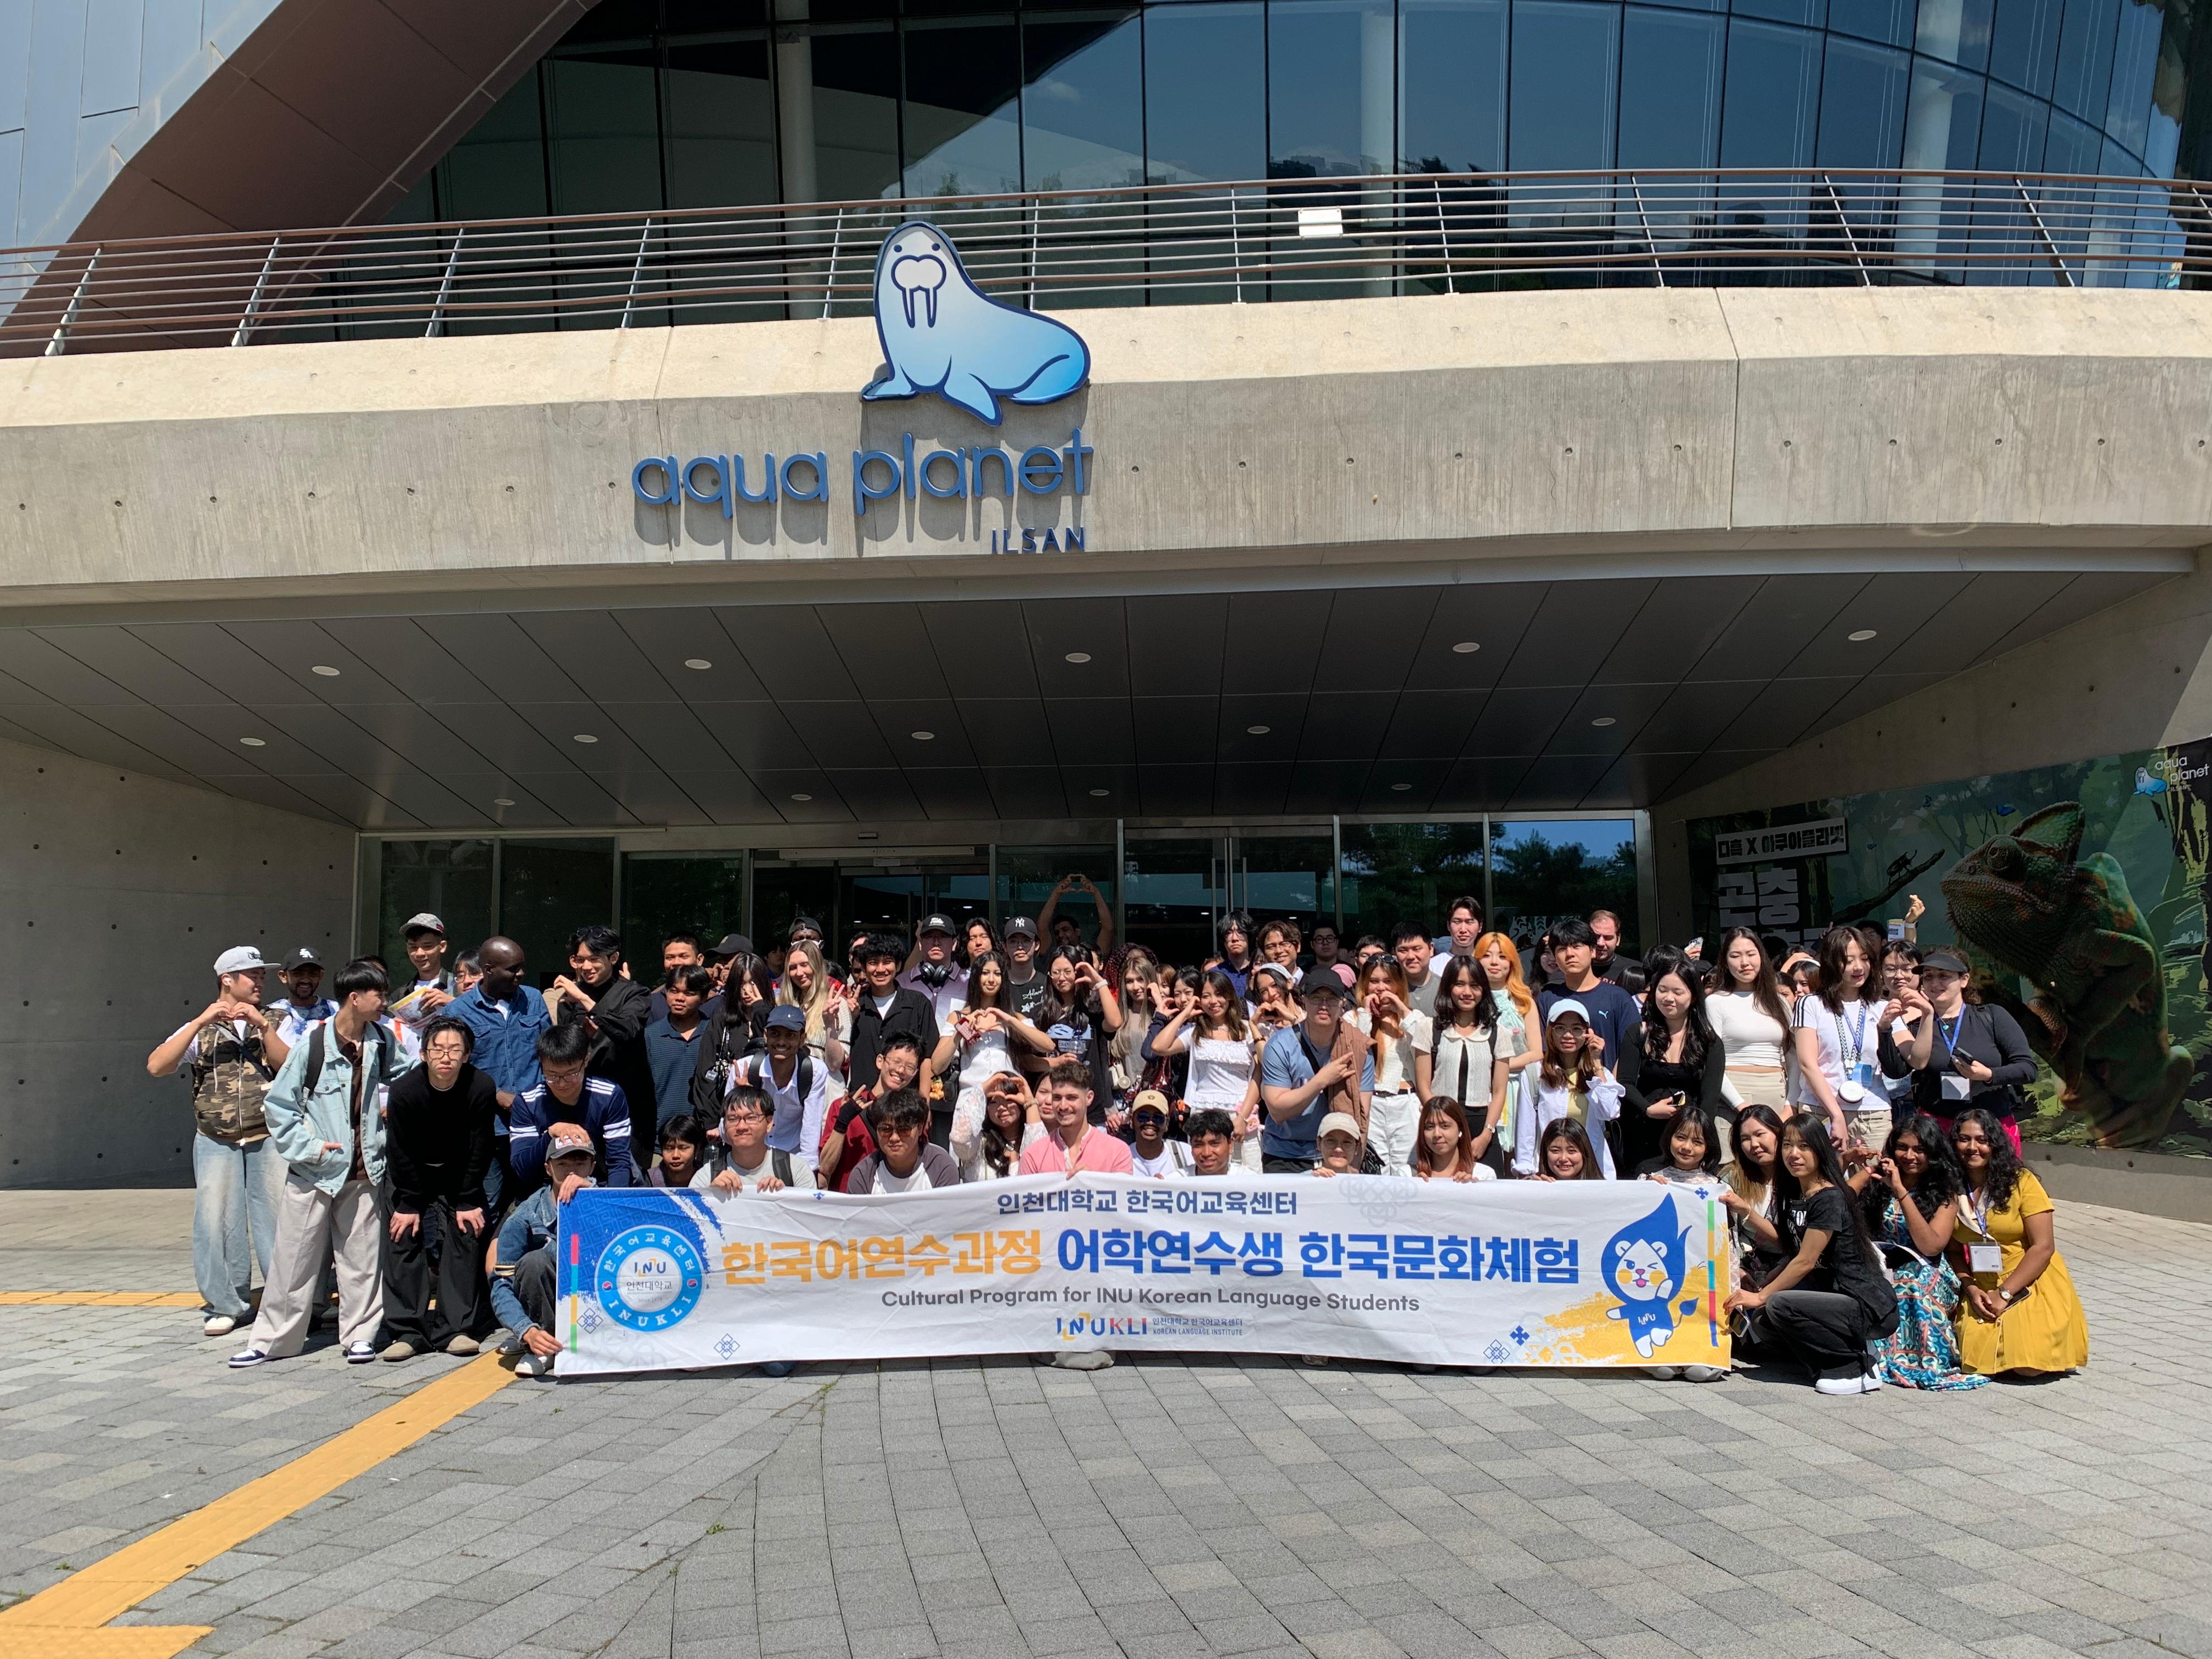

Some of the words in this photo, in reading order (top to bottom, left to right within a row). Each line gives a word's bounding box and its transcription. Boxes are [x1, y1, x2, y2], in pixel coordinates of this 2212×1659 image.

[632, 450, 829, 519] aqua
[853, 427, 1094, 515] planet
[992, 527, 1085, 554] ILSAN
[2155, 757, 2187, 771] aqua
[2170, 763, 2210, 785] planet
[1718, 867, 1799, 928] 곤충
[997, 1188, 1118, 1215] 인천대학교
[1126, 1189, 1297, 1216] 한국어교육센터
[604, 1233, 695, 1272] 한국어교육센터
[721, 1229, 1042, 1285] 한국어연수과정
[1058, 1228, 1284, 1277] 어학연수생
[1299, 1231, 1579, 1284] 한국문화체험
[634, 1260, 667, 1274] INU
[626, 1280, 673, 1291] 인천대학교
[881, 1289, 964, 1307] Cultural
[969, 1288, 1057, 1306] Program
[1063, 1286, 1091, 1302] for
[1097, 1288, 1133, 1304] INU
[1139, 1288, 1211, 1304] Korean
[1217, 1289, 1322, 1310] Language
[1327, 1292, 1420, 1311] Students
[608, 1295, 692, 1327] INUKLI
[1152, 1317, 1189, 1326] 인천대학교
[1192, 1318, 1243, 1327] 한국어교육센터
[1056, 1316, 1148, 1336] INUKLI
